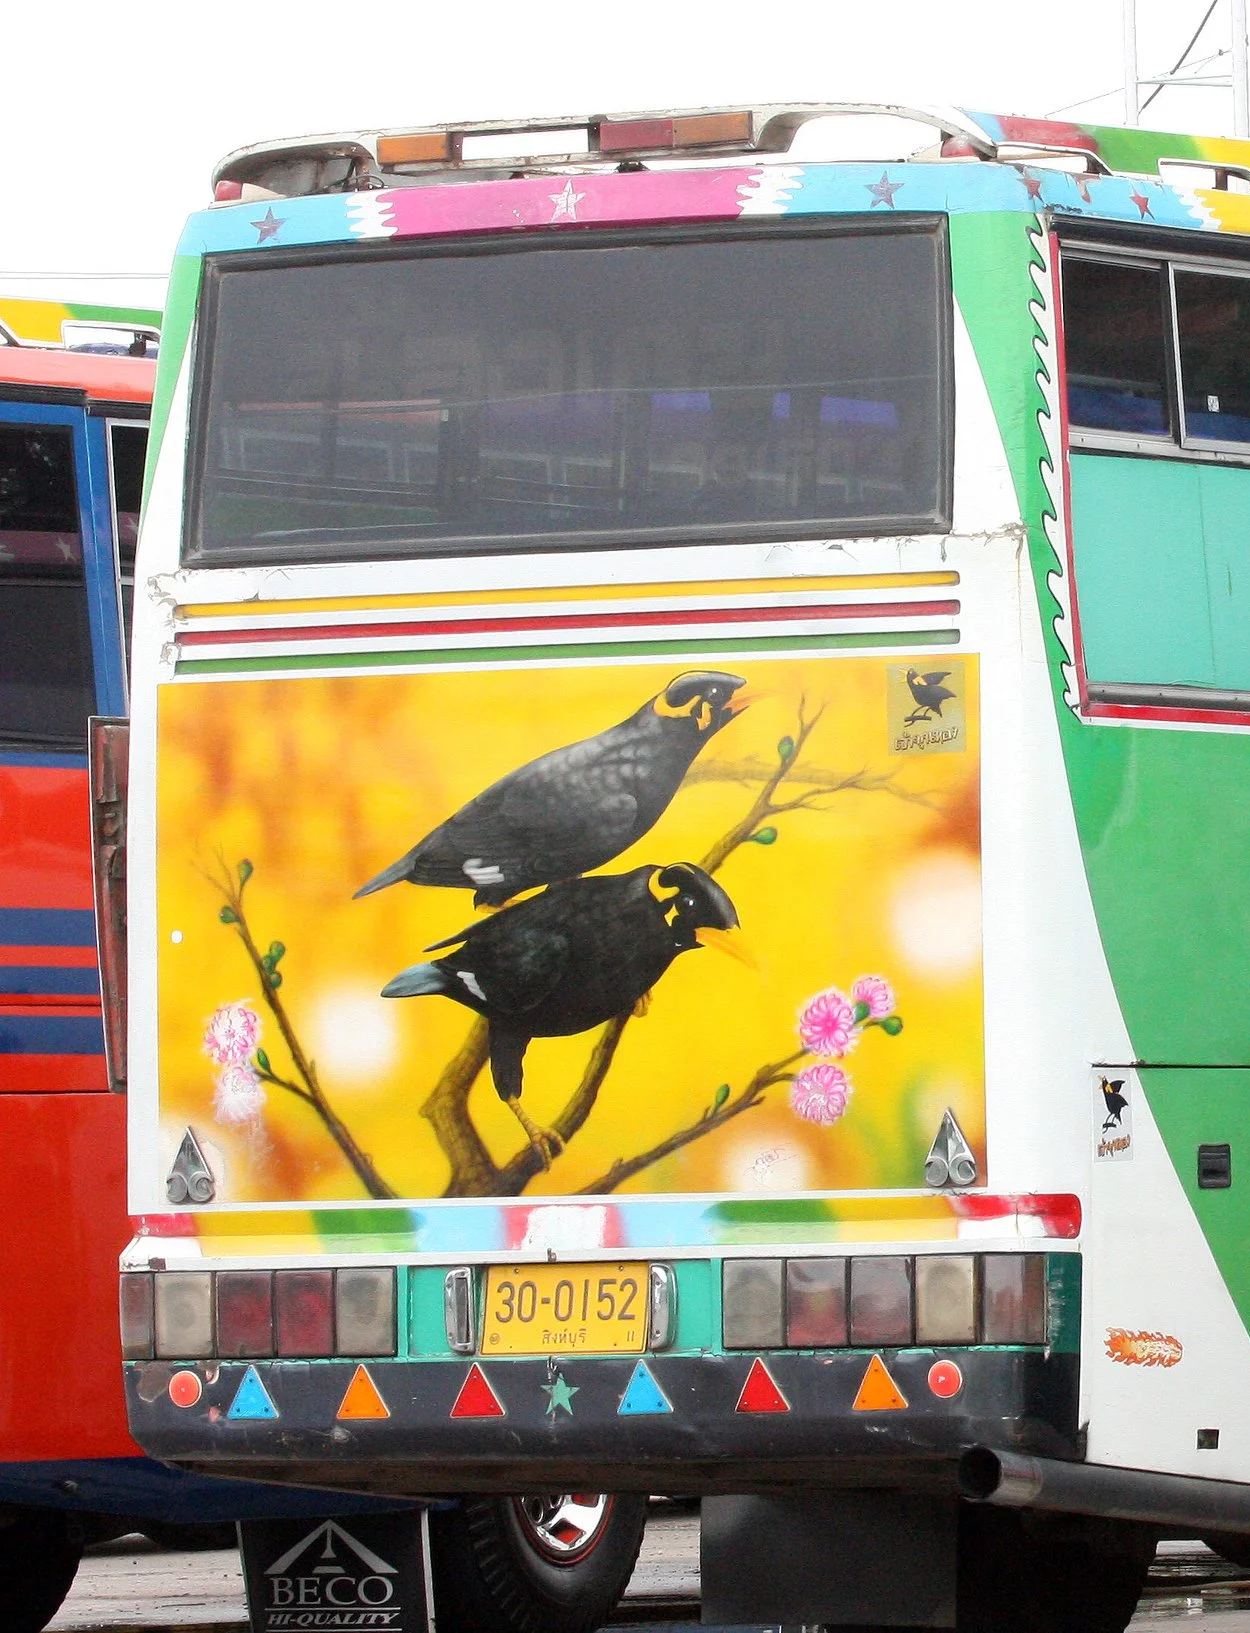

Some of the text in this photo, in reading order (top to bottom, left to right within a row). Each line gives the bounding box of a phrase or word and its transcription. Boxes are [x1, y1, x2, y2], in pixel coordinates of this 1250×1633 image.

[495, 1278, 638, 1323] 30-0152
[541, 1328, 587, 1348] สิงห์บุรี
[269, 1576, 394, 1605] BECO
[267, 1612, 400, 1627] HI-QUALITY
